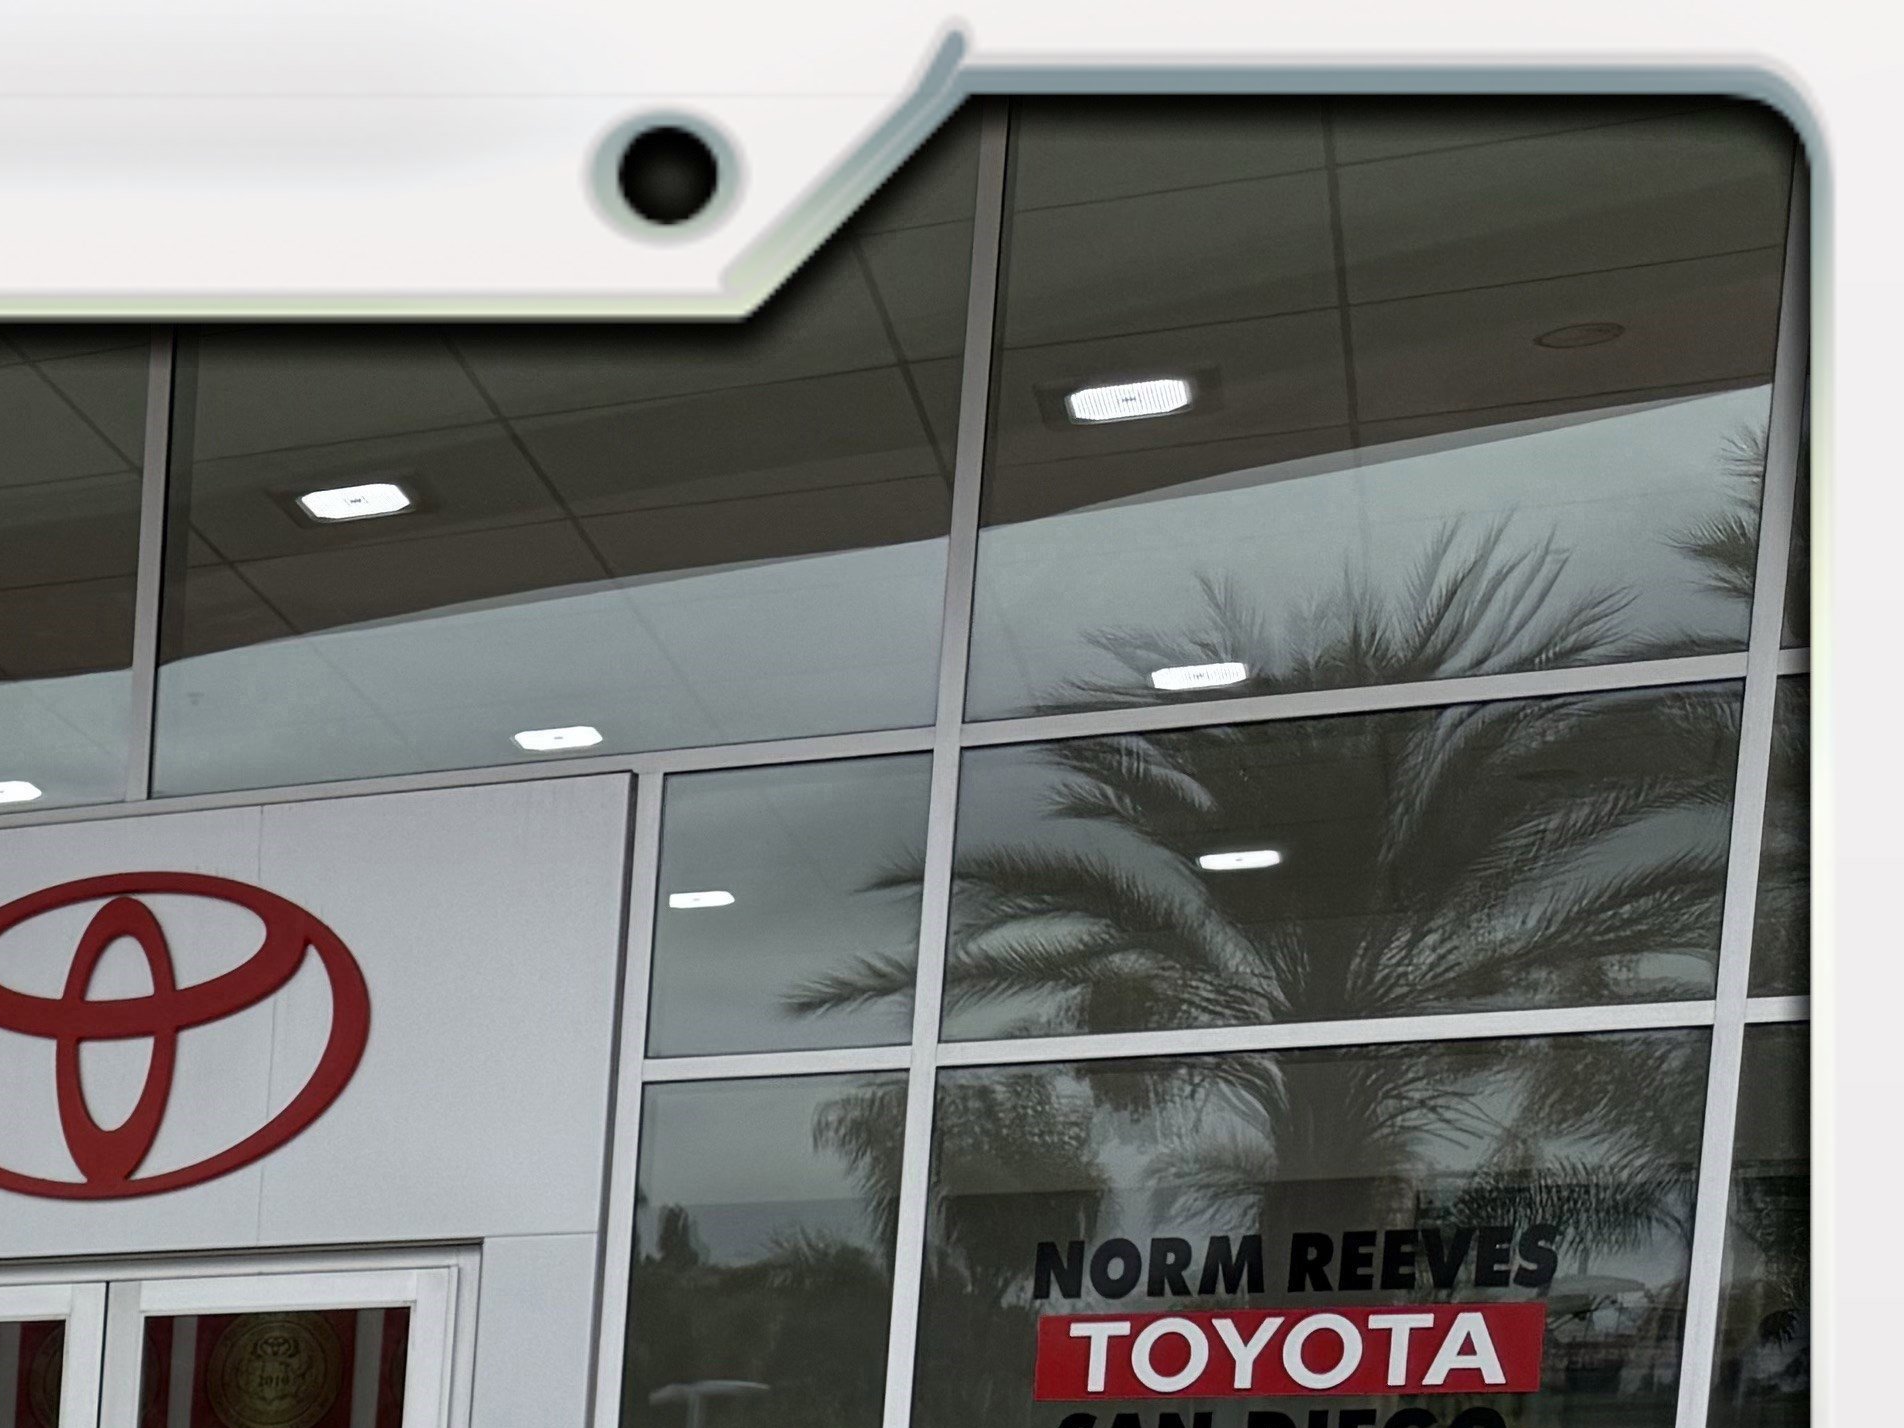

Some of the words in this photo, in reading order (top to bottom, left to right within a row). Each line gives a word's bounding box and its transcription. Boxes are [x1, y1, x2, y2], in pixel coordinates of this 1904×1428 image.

[1033, 1234, 1265, 1299] NORM
[1286, 1223, 1560, 1292] REEVES
[1069, 1311, 1508, 1393] TOYOTA
